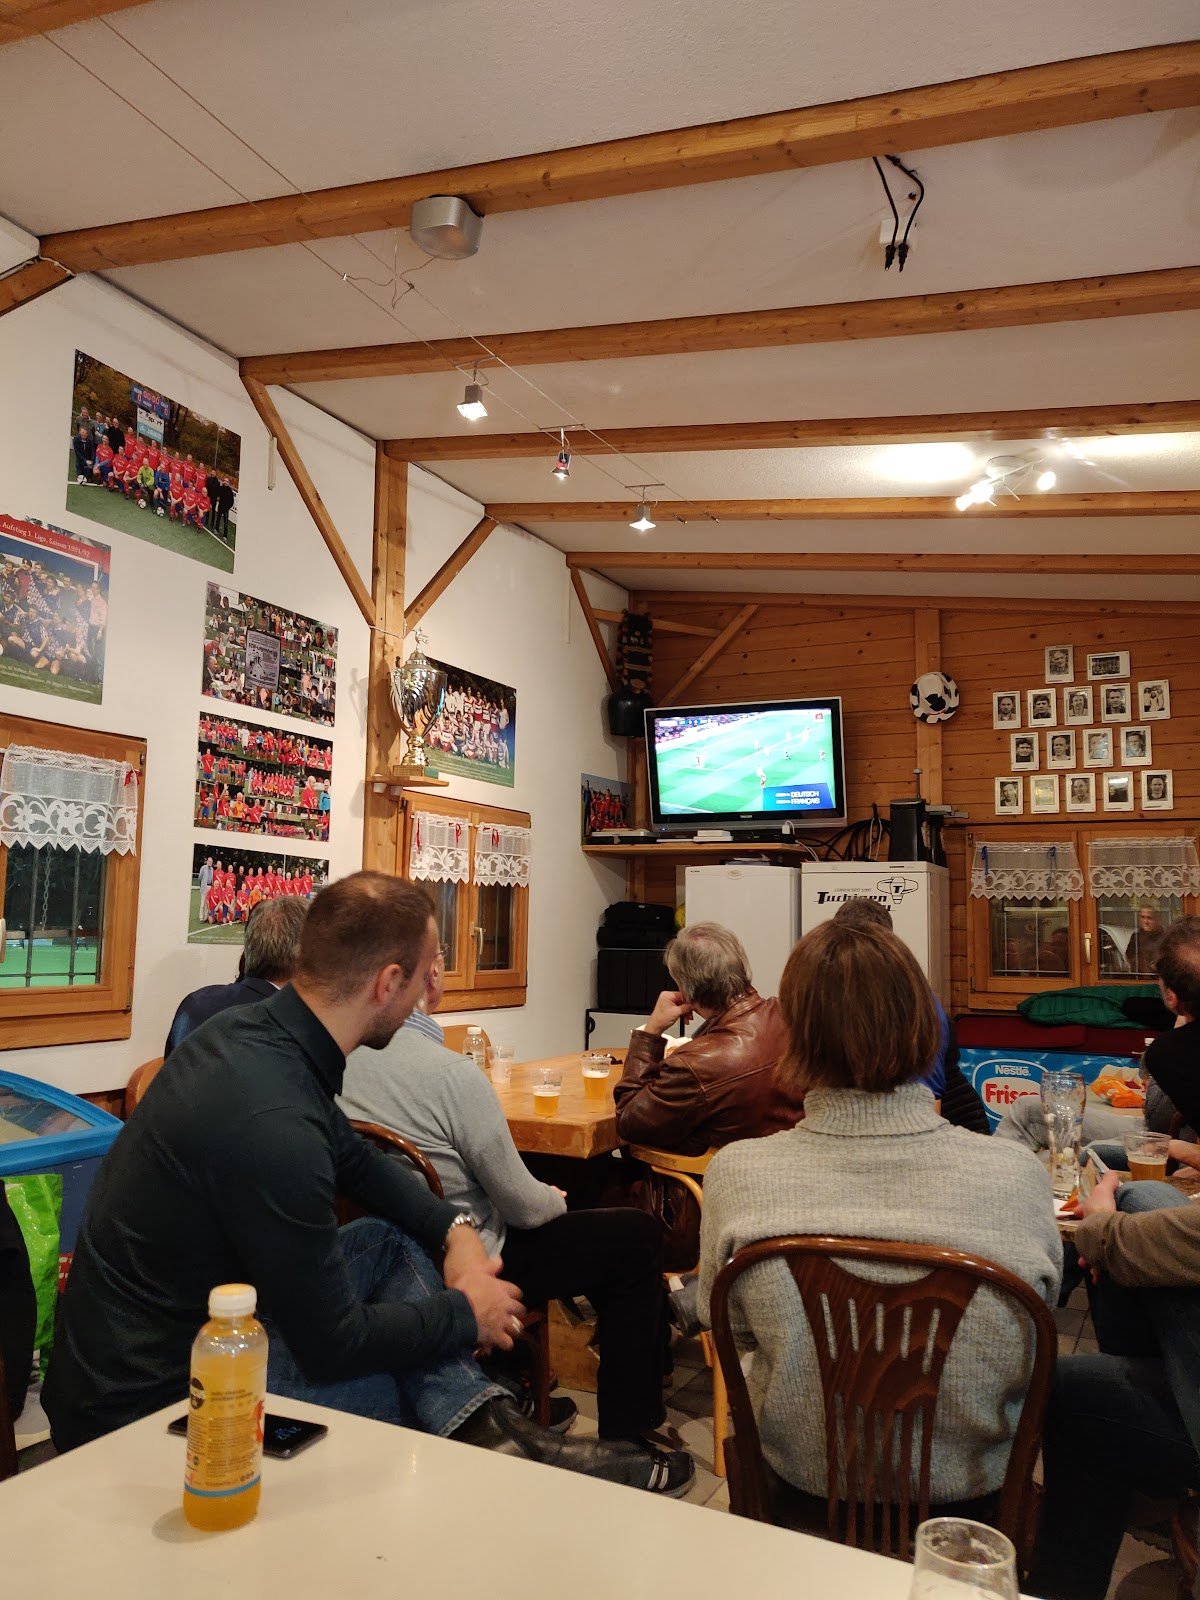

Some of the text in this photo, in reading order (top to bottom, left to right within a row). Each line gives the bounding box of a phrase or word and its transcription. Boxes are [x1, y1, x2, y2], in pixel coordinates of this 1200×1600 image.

[2, 521, 27, 536] Aufstieg
[49, 537, 67, 550] Saison
[790, 790, 820, 798] DEUTSCH
[790, 797, 821, 805] FRANÇAIS
[995, 1065, 1029, 1076] Nestlé
